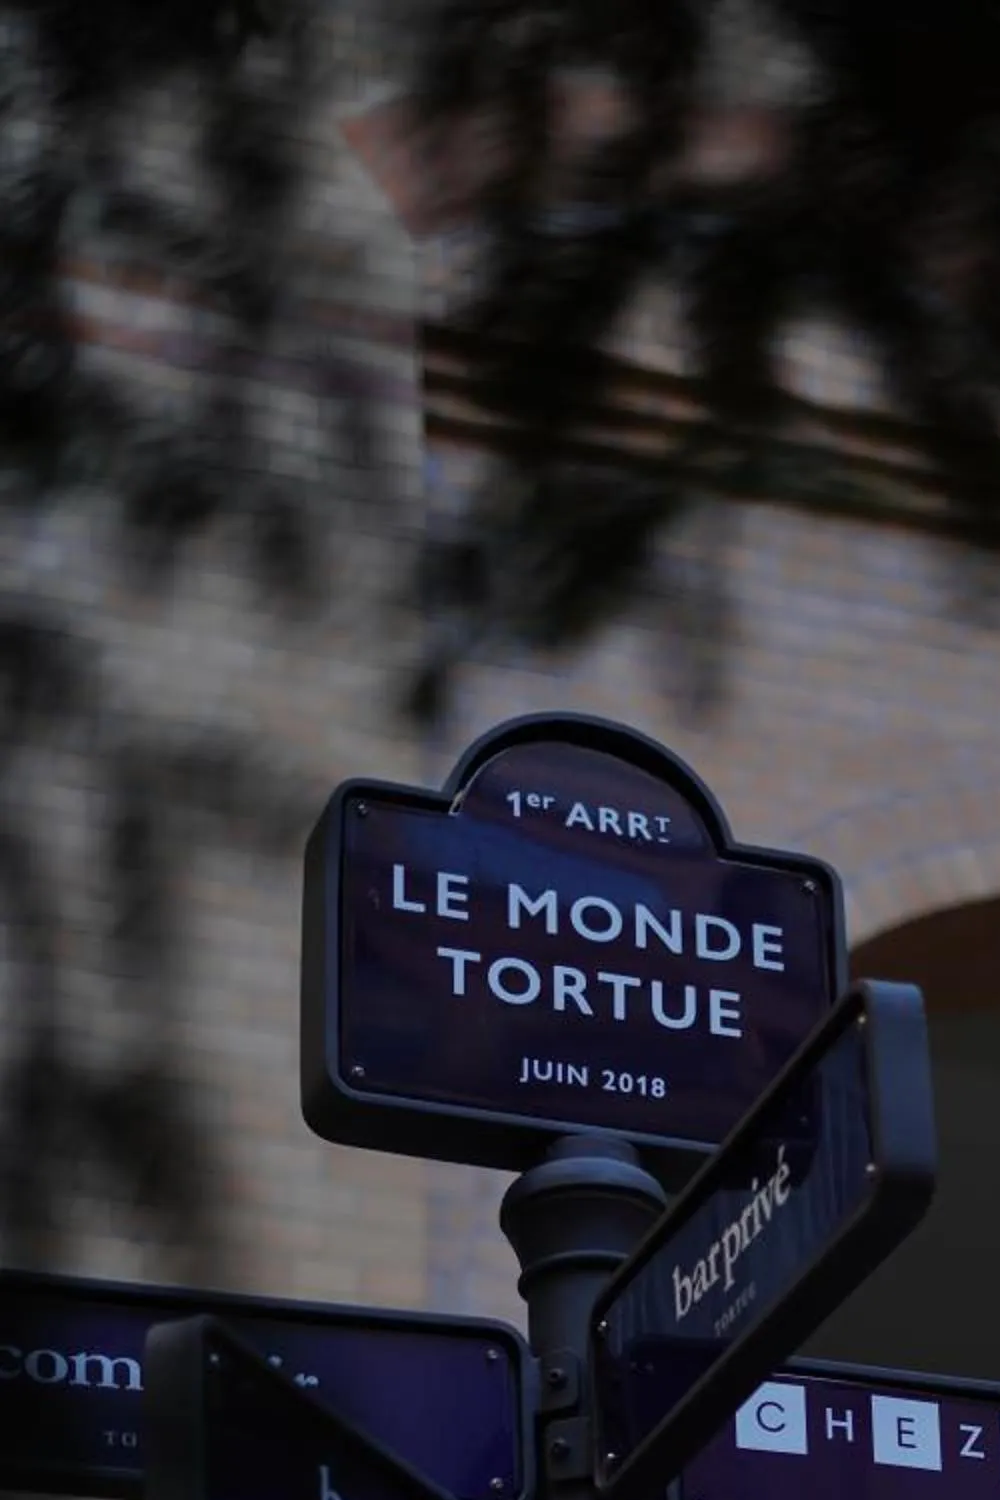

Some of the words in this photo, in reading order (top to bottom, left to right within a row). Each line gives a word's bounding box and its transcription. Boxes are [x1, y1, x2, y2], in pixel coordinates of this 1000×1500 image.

[506, 790, 555, 818] 1er
[391, 864, 471, 922] LE
[506, 883, 786, 972] MONDE
[436, 946, 744, 1039] TORTUE
[518, 1056, 589, 1087] JUIN
[601, 1073, 666, 1099] 2018
[755, 1400, 986, 1460] CHEZ
